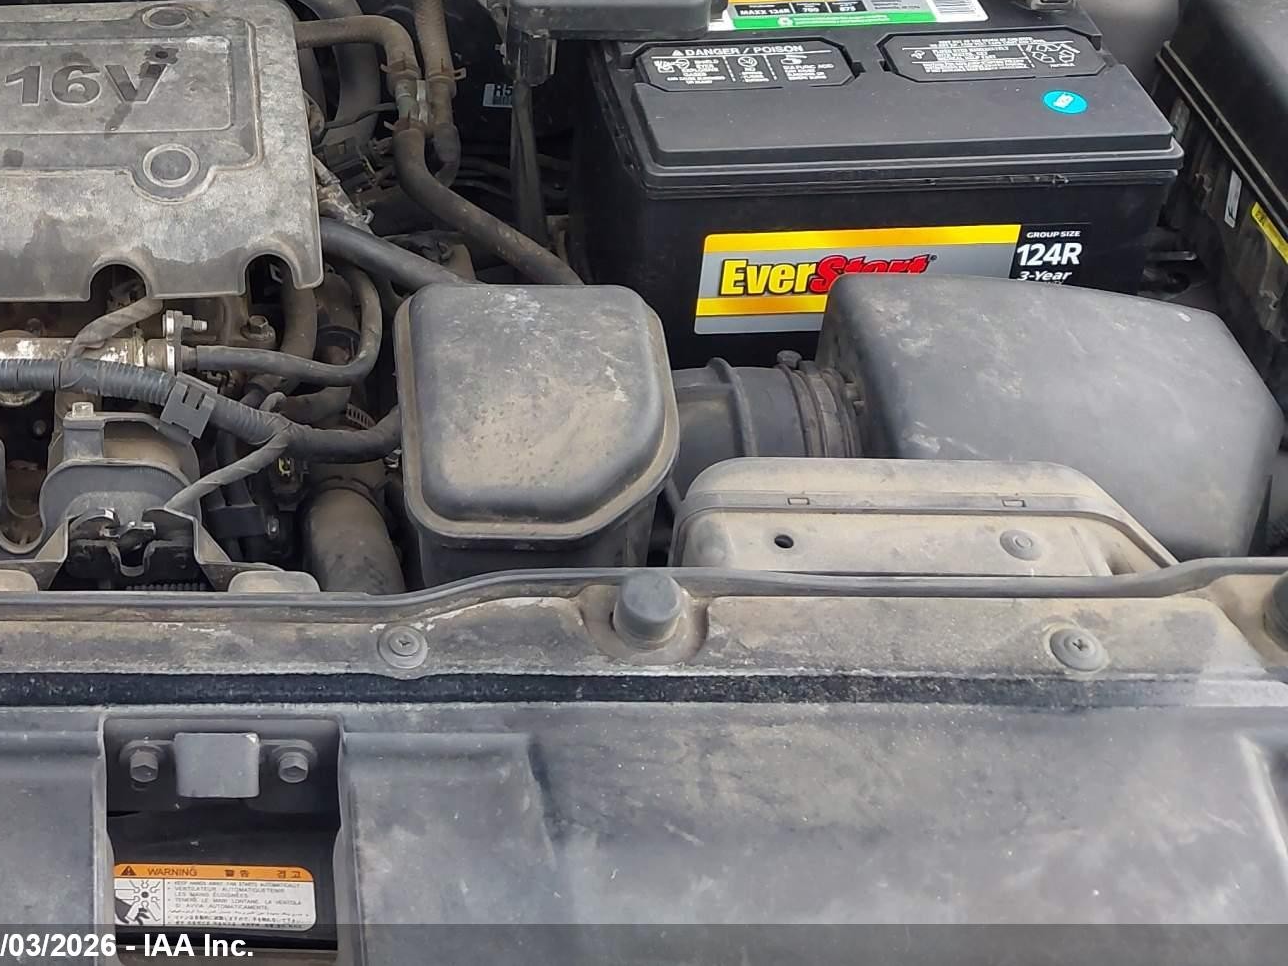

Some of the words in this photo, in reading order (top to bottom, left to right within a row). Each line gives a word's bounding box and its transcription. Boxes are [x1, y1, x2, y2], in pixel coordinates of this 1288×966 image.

[685, 47, 740, 57] DANGER
[753, 44, 804, 54] POISON
[4, 63, 168, 108] 16V
[1026, 231, 1060, 239] GROUP
[1060, 230, 1081, 238] SIZE
[1016, 242, 1083, 266] 124R
[1016, 270, 1073, 281] 3-Year
[147, 867, 198, 877] WARNING
